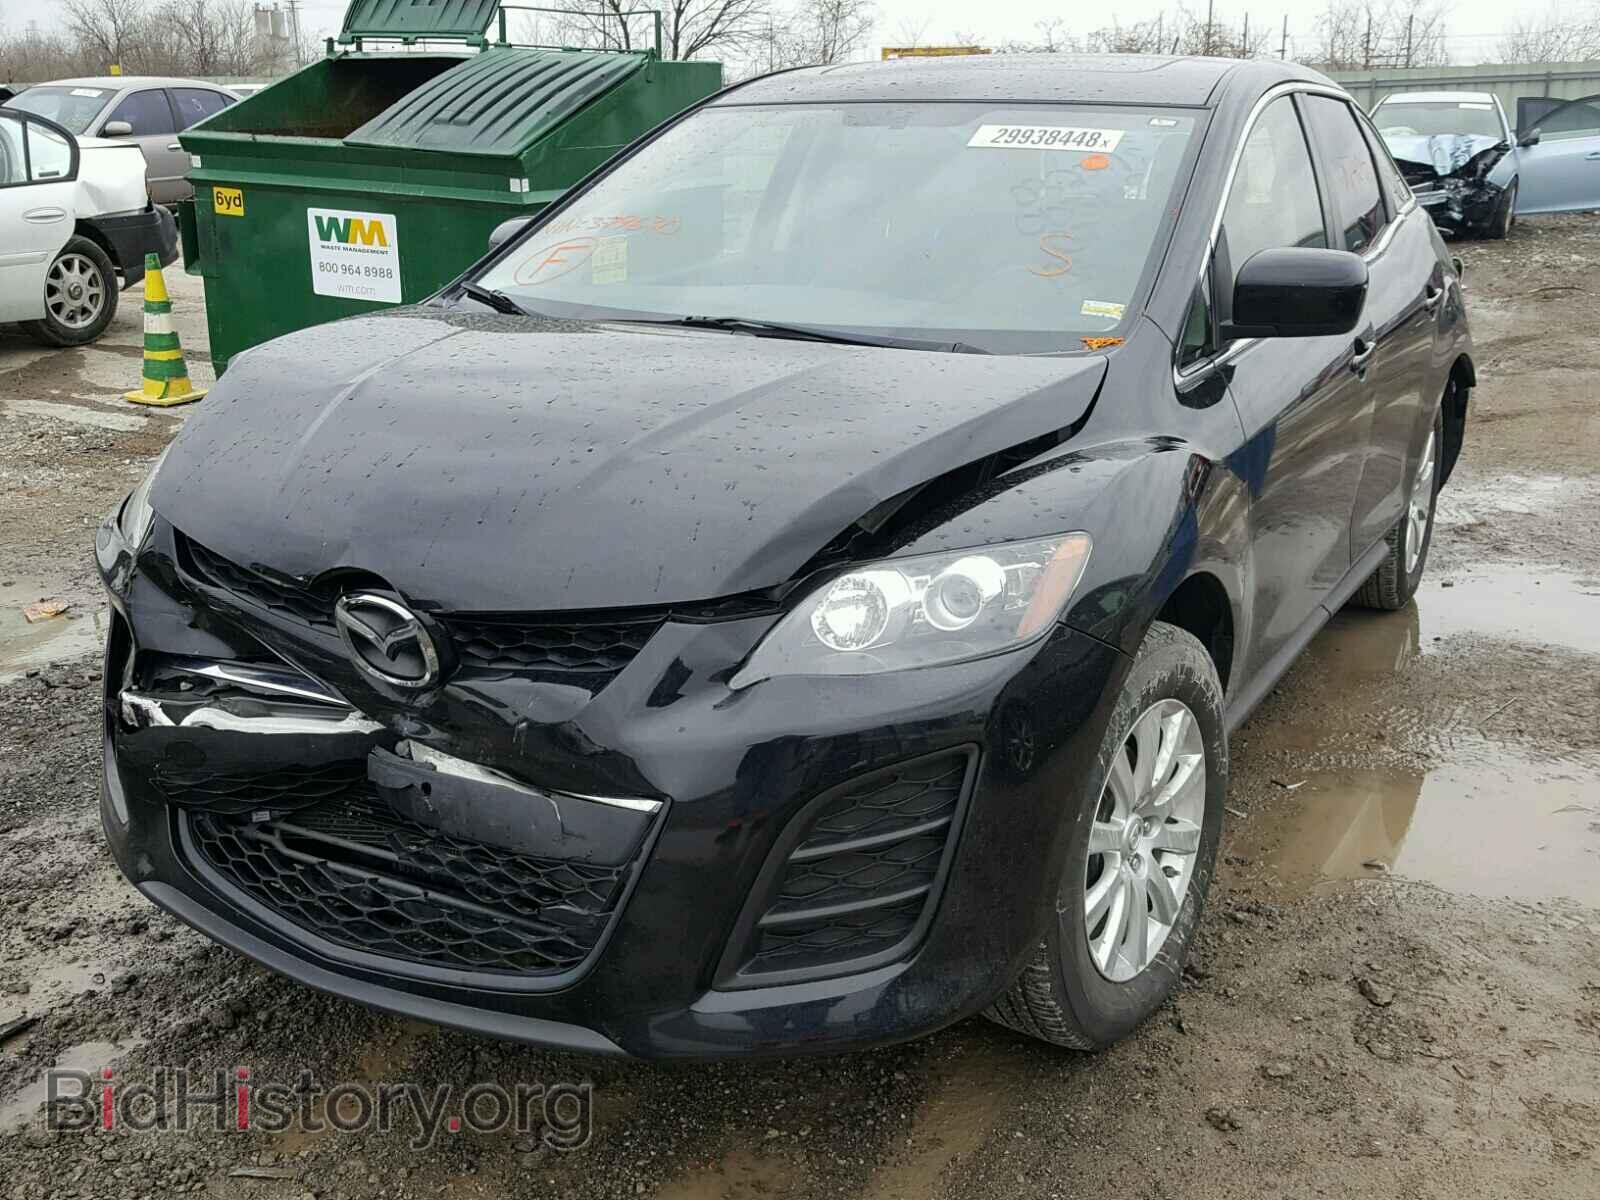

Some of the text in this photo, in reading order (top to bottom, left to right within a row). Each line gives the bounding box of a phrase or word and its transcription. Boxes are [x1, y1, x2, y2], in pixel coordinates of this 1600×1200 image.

[215, 191, 242, 210] 6yd
[314, 215, 388, 247] WM
[343, 246, 389, 255] MANAGEMENT
[1024, 232, 1073, 278] S
[319, 261, 393, 279] 800 964 8988
[528, 244, 591, 280] F
[337, 284, 376, 296] wm.com
